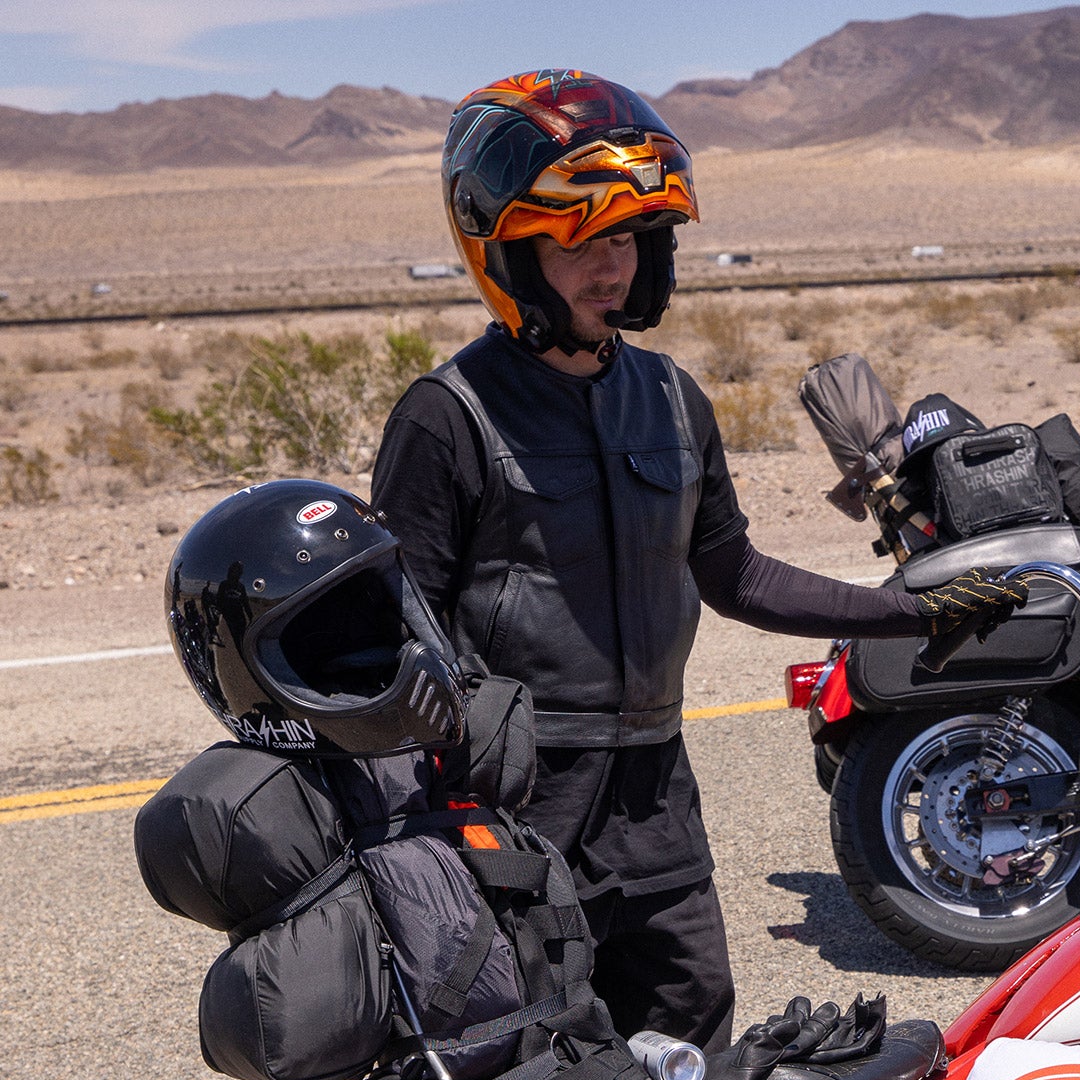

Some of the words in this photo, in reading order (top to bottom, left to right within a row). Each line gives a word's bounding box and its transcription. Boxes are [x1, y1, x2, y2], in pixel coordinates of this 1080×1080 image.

[303, 504, 332, 520] BELL
[222, 714, 316, 747] RASHIN
[272, 741, 316, 749] COMPANY
